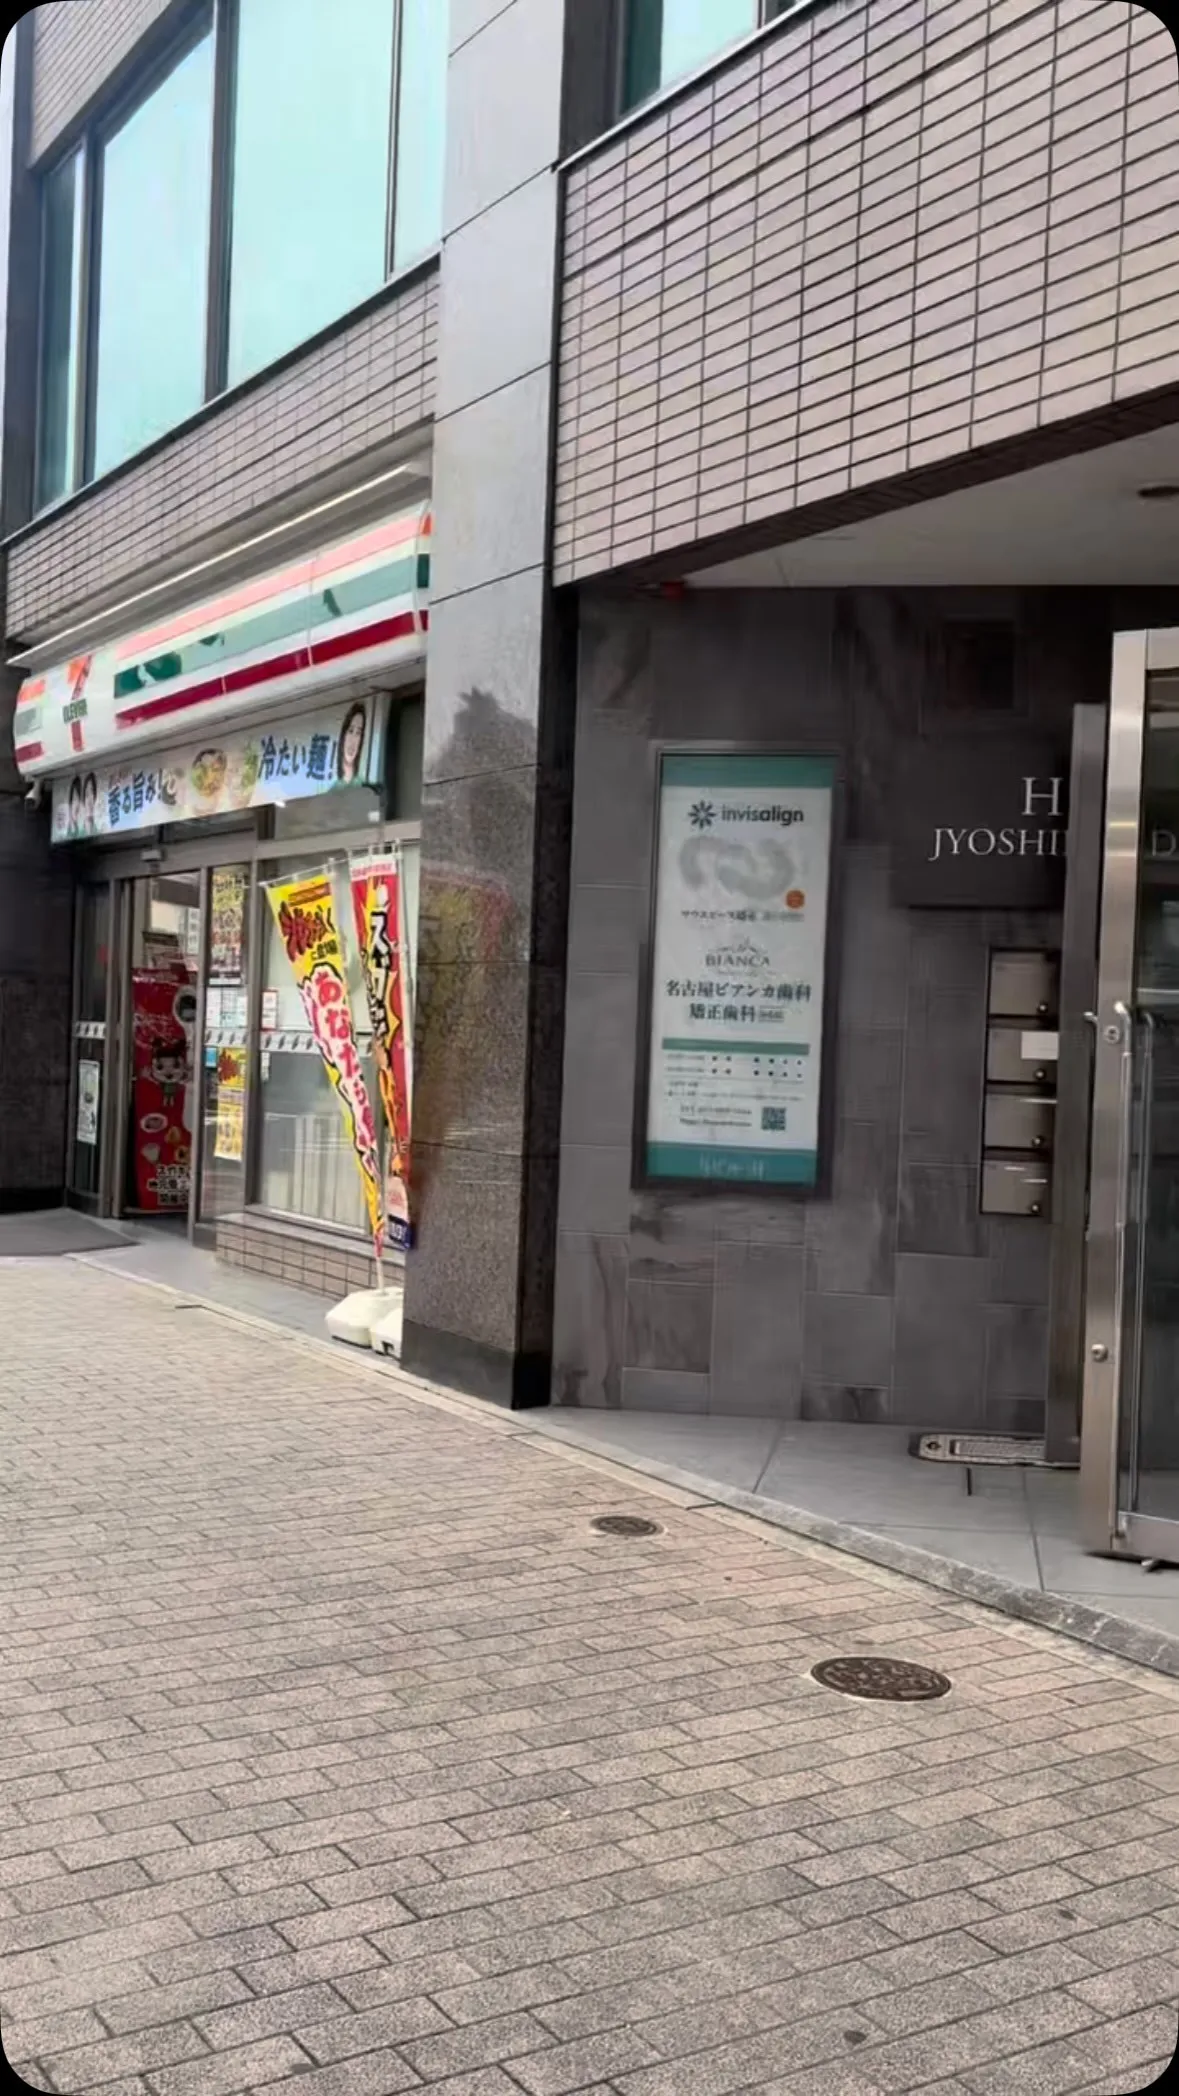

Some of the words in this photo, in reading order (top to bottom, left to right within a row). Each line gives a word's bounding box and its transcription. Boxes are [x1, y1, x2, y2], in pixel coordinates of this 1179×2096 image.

[721, 805, 804, 826] invisalign
[928, 828, 1067, 861] JYOSHI
[705, 955, 770, 968] BIANCA
